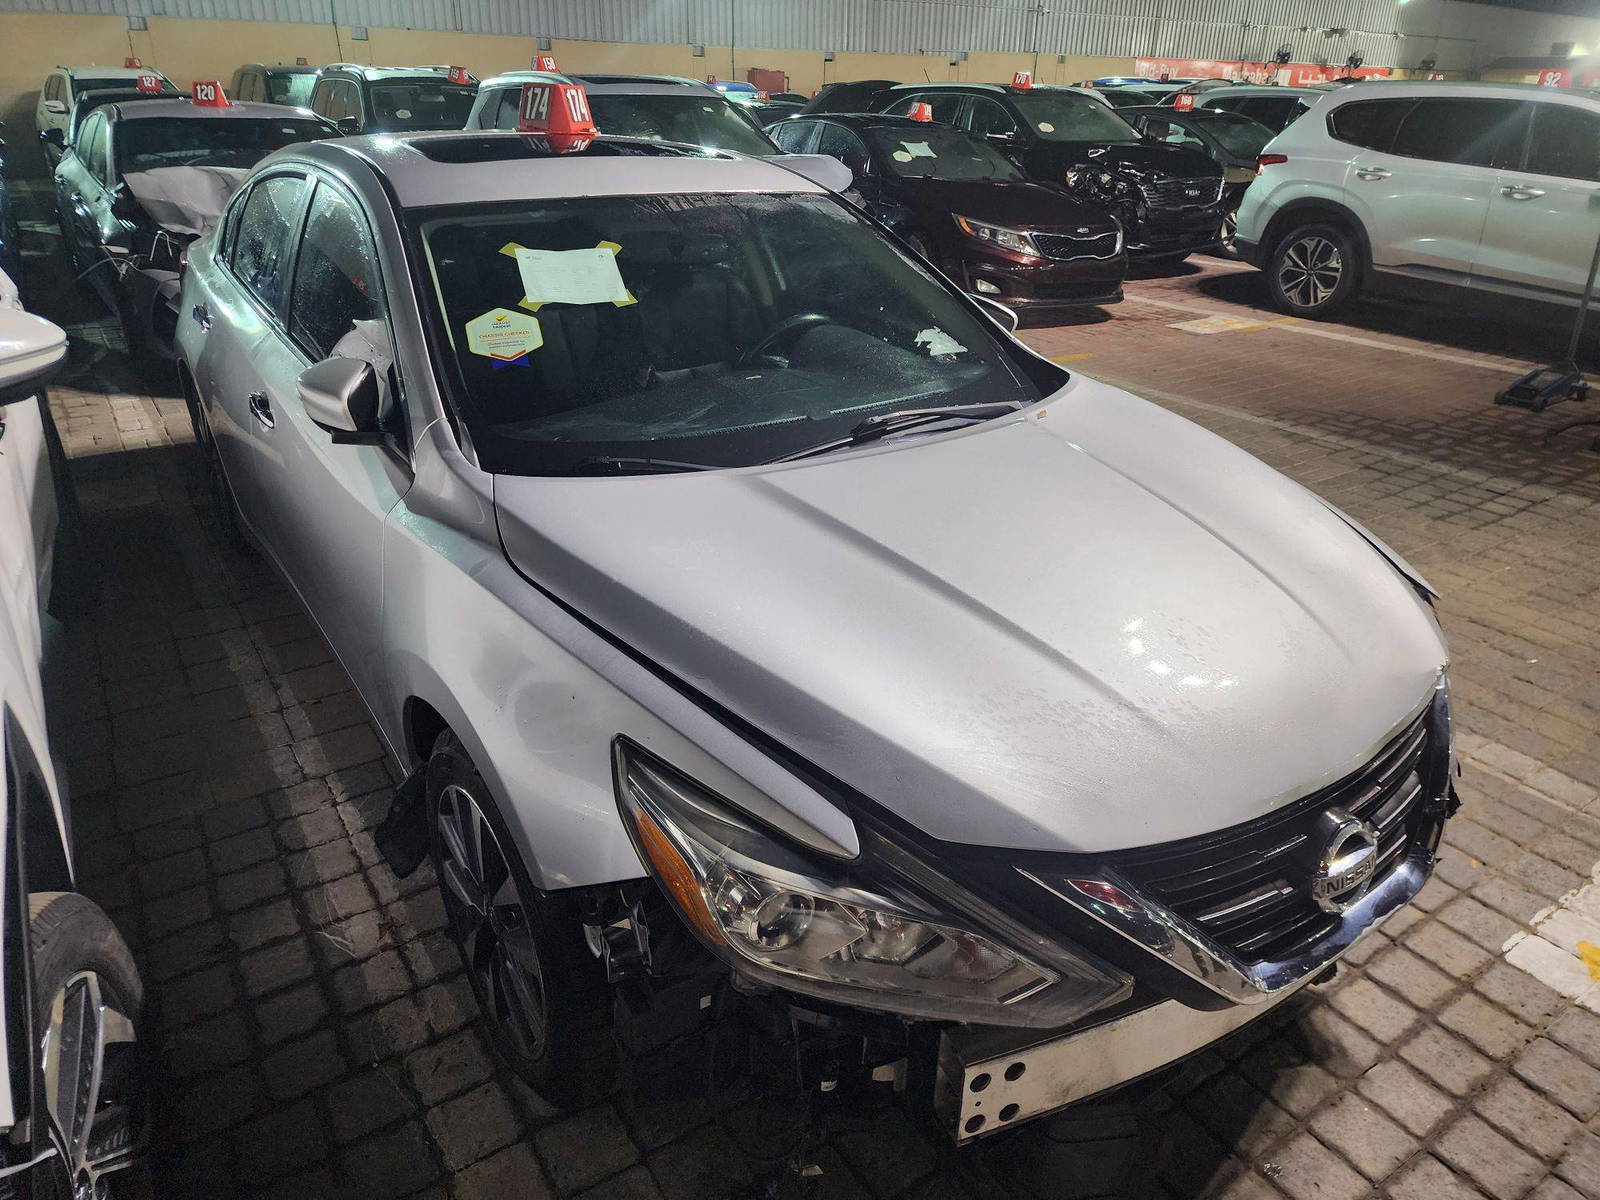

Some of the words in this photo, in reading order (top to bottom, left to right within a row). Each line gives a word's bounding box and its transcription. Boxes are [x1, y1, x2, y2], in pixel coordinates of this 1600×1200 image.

[142, 76, 156, 88] 127
[196, 84, 215, 101] 120
[1543, 72, 1562, 88] 92
[525, 87, 550, 120] 174
[566, 88, 590, 122] 174
[1326, 856, 1374, 895] NISSA
